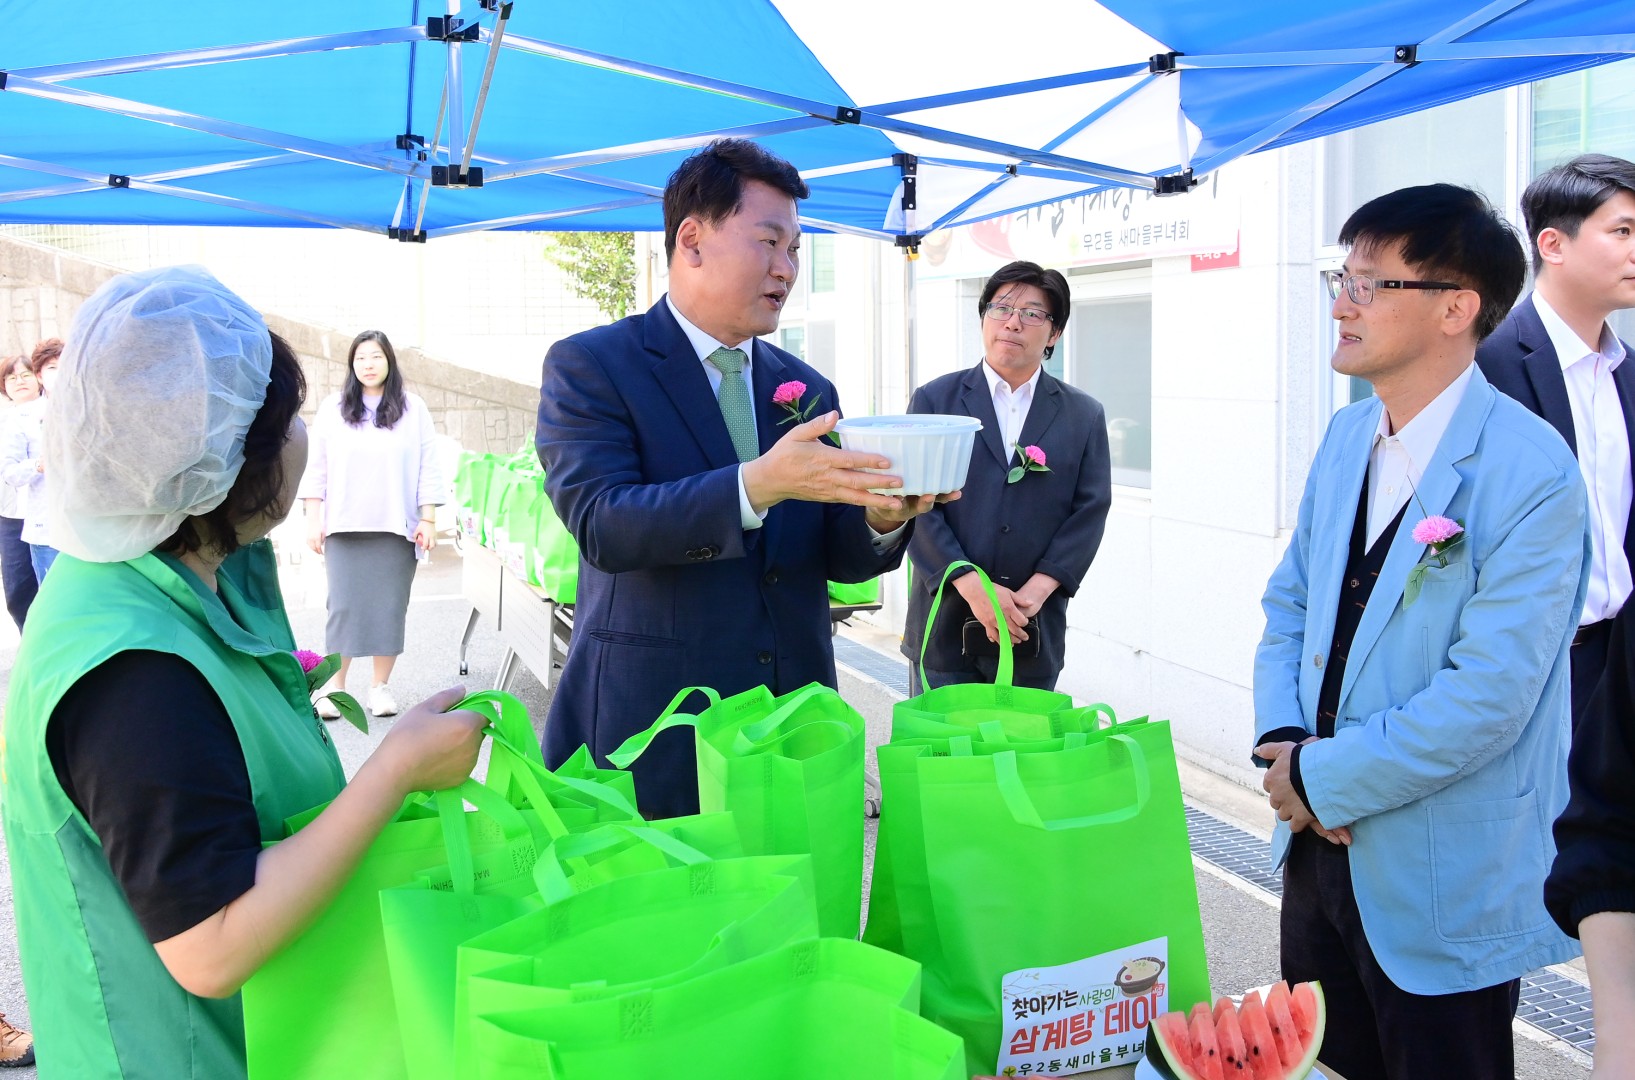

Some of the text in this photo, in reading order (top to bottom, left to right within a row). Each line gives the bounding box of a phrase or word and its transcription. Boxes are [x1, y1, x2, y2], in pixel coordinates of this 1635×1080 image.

[1083, 219, 1190, 252] 우2동 새마을부녀회
[1012, 987, 1115, 1020] 찾아가는 사랑의
[1010, 994, 1157, 1055] 삼계탕 데이
